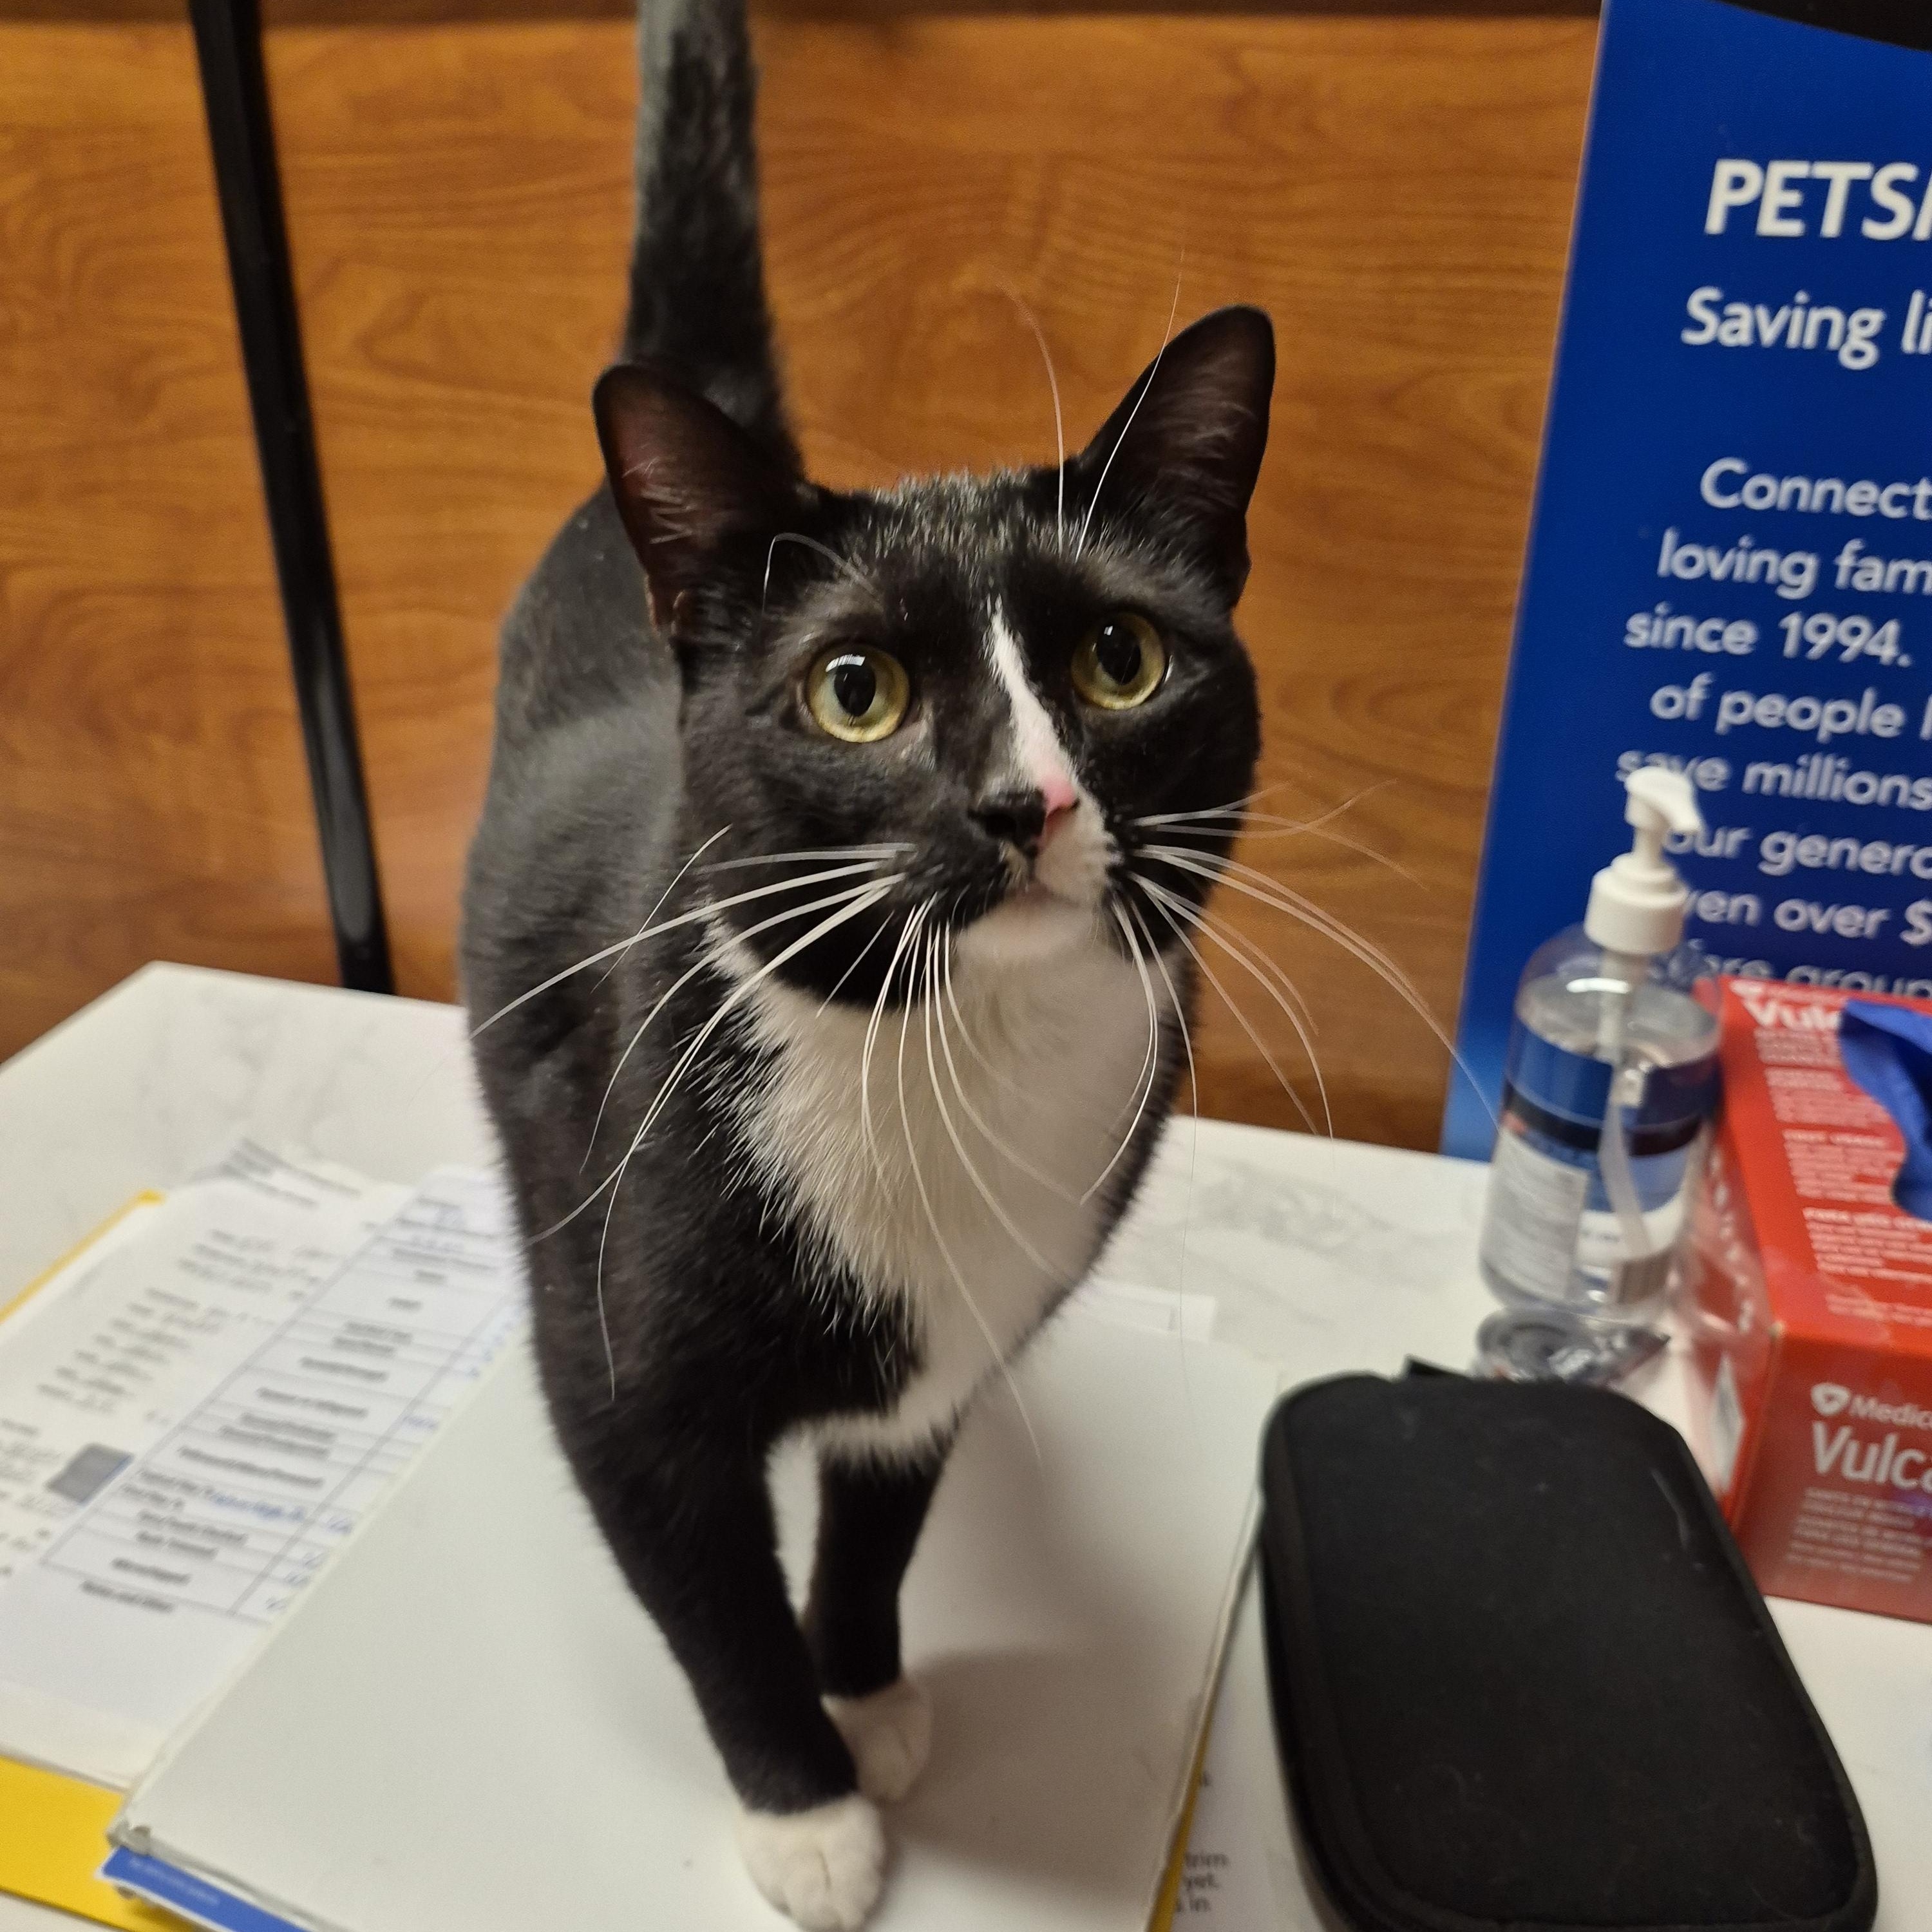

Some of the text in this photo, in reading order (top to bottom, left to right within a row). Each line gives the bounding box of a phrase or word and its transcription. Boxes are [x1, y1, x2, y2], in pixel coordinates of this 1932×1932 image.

[1681, 286, 1887, 370] Saving
[1700, 457, 1932, 520] Connect
[1657, 526, 1932, 600] loving fam
[1624, 601, 1913, 668] since 1994.
[1650, 672, 1716, 720] of
[1715, 687, 1906, 743] people
[1741, 753, 1932, 811] millions
[1774, 899, 1892, 939] over
